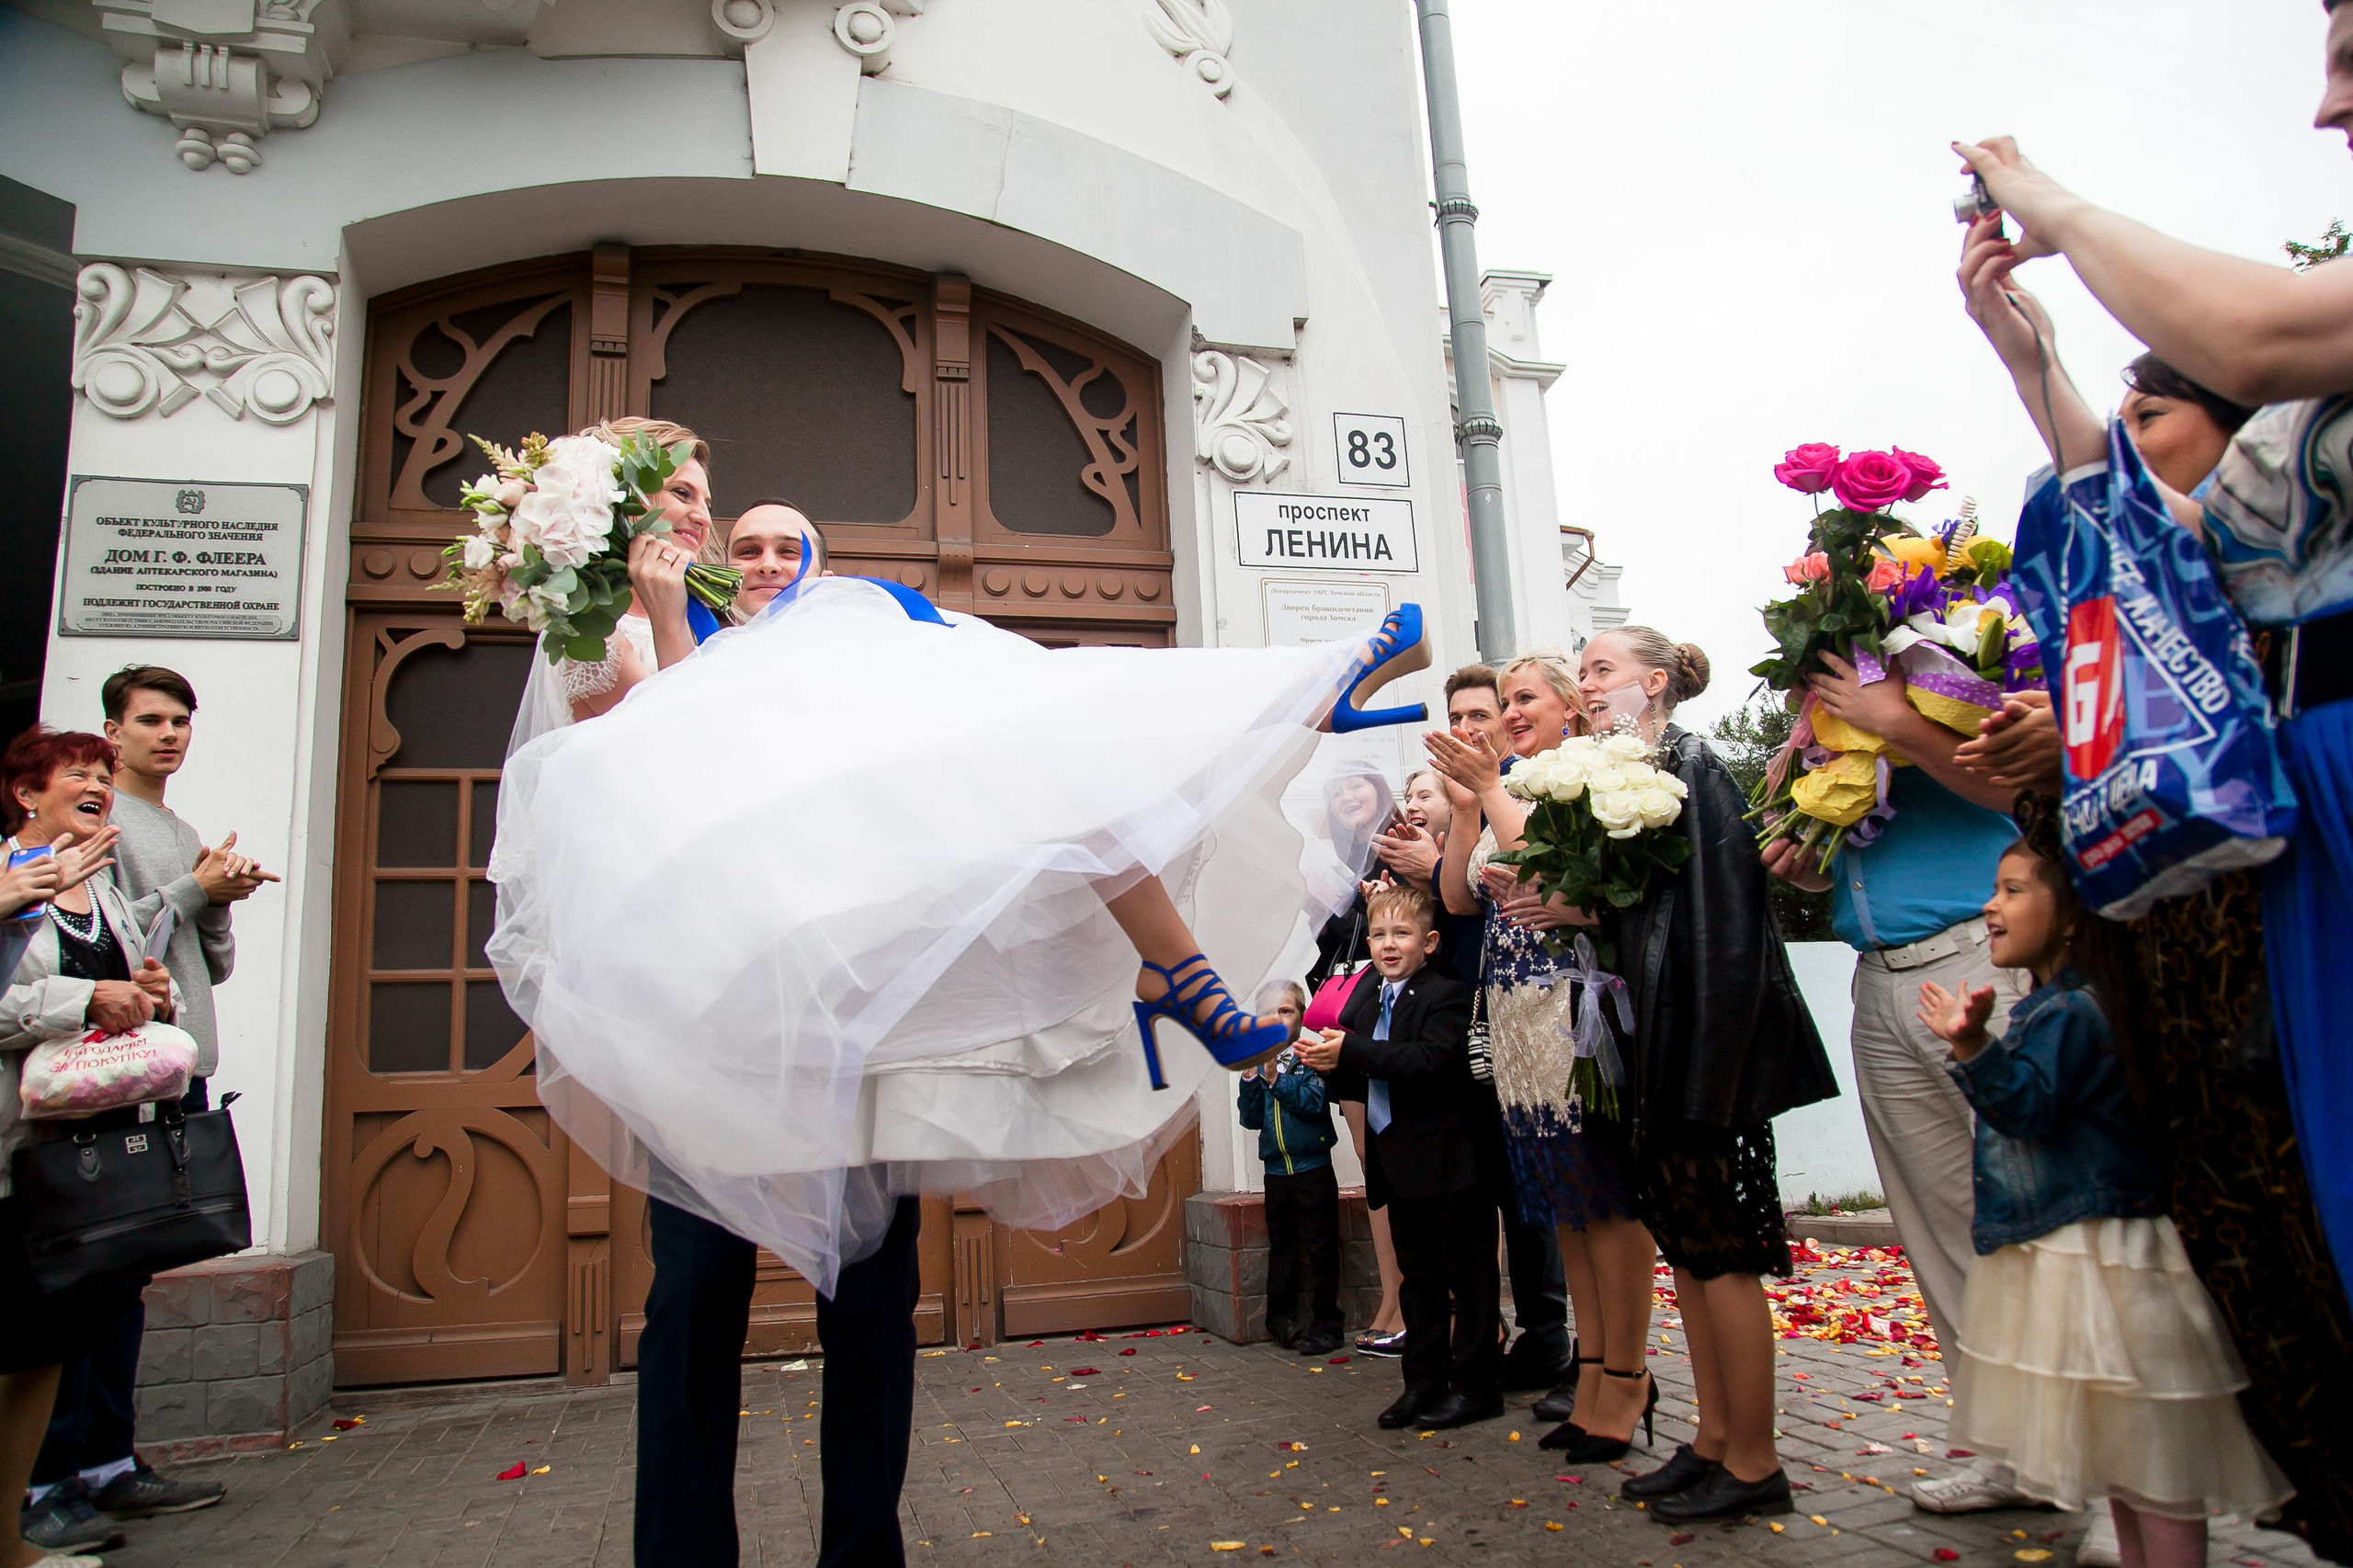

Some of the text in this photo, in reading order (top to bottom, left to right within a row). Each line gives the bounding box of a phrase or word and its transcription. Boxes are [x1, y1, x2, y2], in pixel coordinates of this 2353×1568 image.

[1347, 429, 1397, 470] 83
[1279, 505, 1370, 524] проспект
[96, 517, 278, 531] ОБЪЕКТ КУЛЬТУРНОГО НАСЛЕДИЯ
[119, 528, 264, 541] ФЕДЕРАЛЬНОГО ЗНАЧЕНИЯ
[1265, 528, 1393, 561] ЛЕНИНА
[104, 549, 267, 565] ДОМ Г. Ф. ФЛЕЕРА
[90, 566, 278, 578] (ЗДАНИЕ АПТЕКАРСКОГО МАГАЗИНА)
[136, 584, 186, 592] ПОСТРОЕНО
[83, 597, 279, 610] ПОДЛЕЖИТ ГОСУДАРСТВЕННОЙ ОХРАНЕ
[1280, 604, 1374, 614] Дворец бракосочетаний
[2121, 593, 2232, 715] КАЧЕСТВО
[51, 1049, 157, 1074] ЗА ПОКУПКУ!
